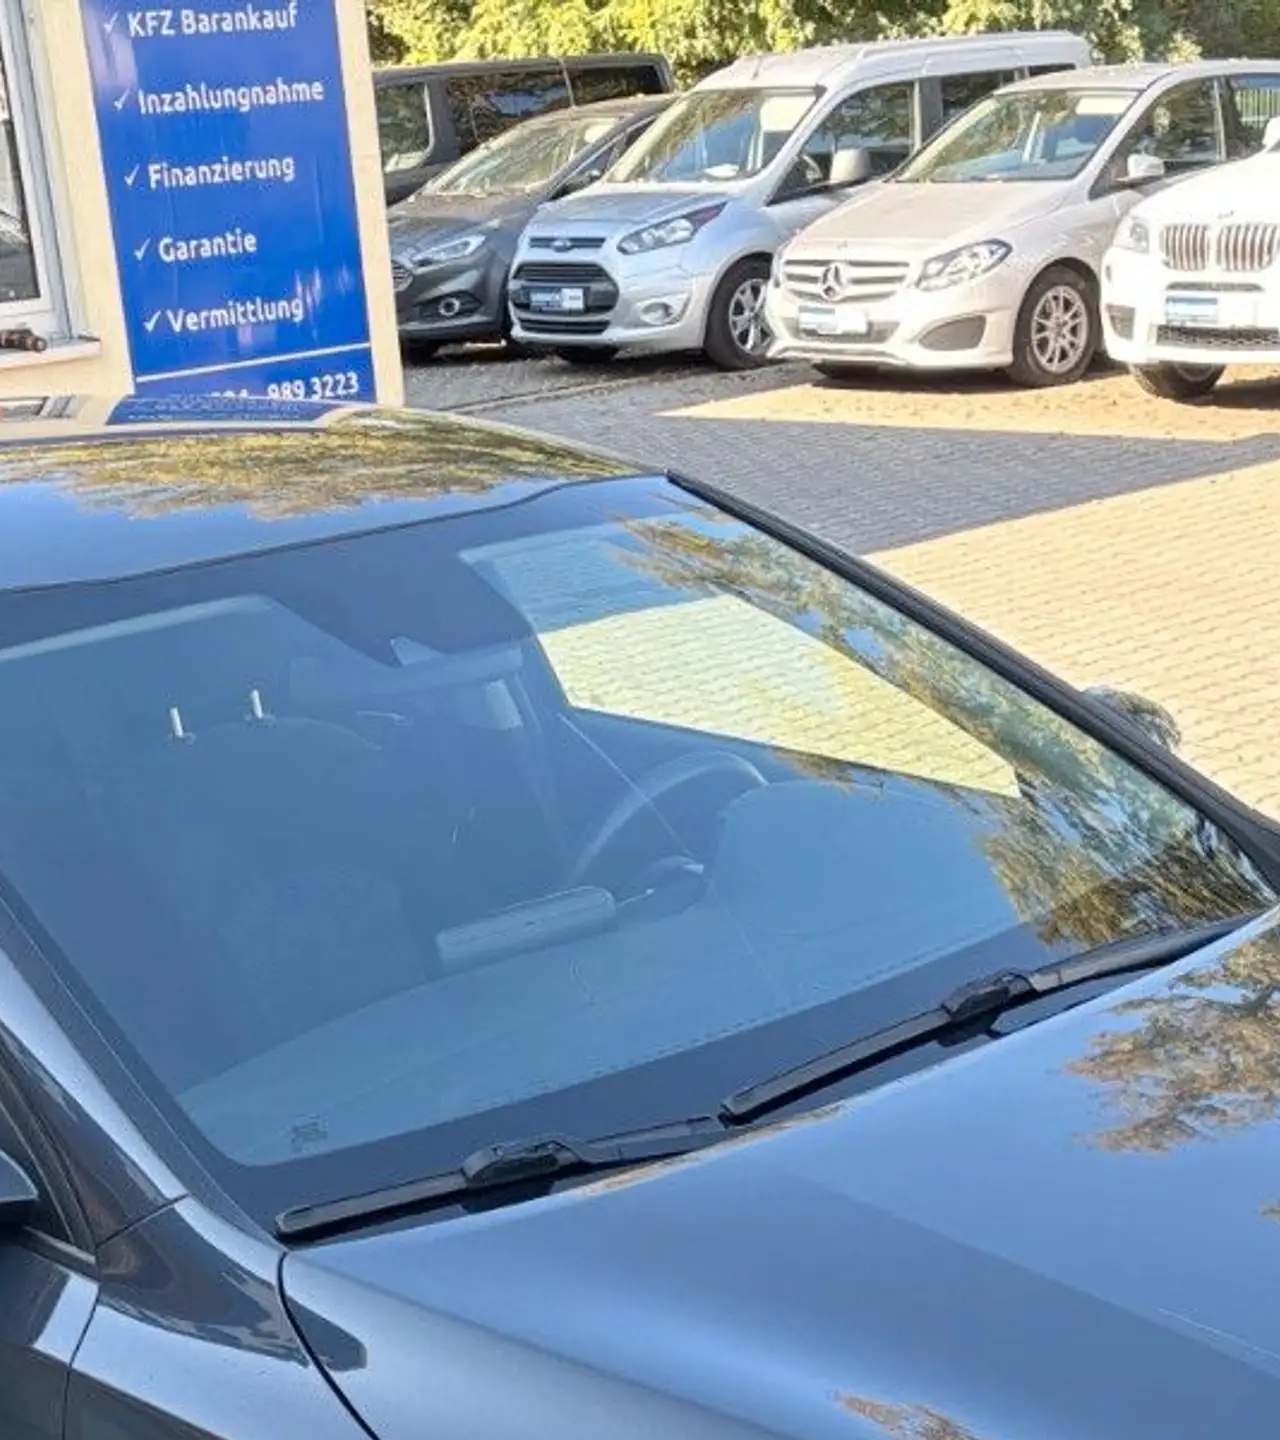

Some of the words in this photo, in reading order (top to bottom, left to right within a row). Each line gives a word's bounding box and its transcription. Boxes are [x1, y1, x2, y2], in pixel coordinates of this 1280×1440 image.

[128, 9, 175, 37] KFZ
[181, 2, 298, 34] Barankauf
[138, 77, 325, 115] Inzahlungnahme
[148, 155, 296, 190] Finanzierung
[159, 227, 258, 262] Garantie
[167, 297, 304, 333] Vermittlung
